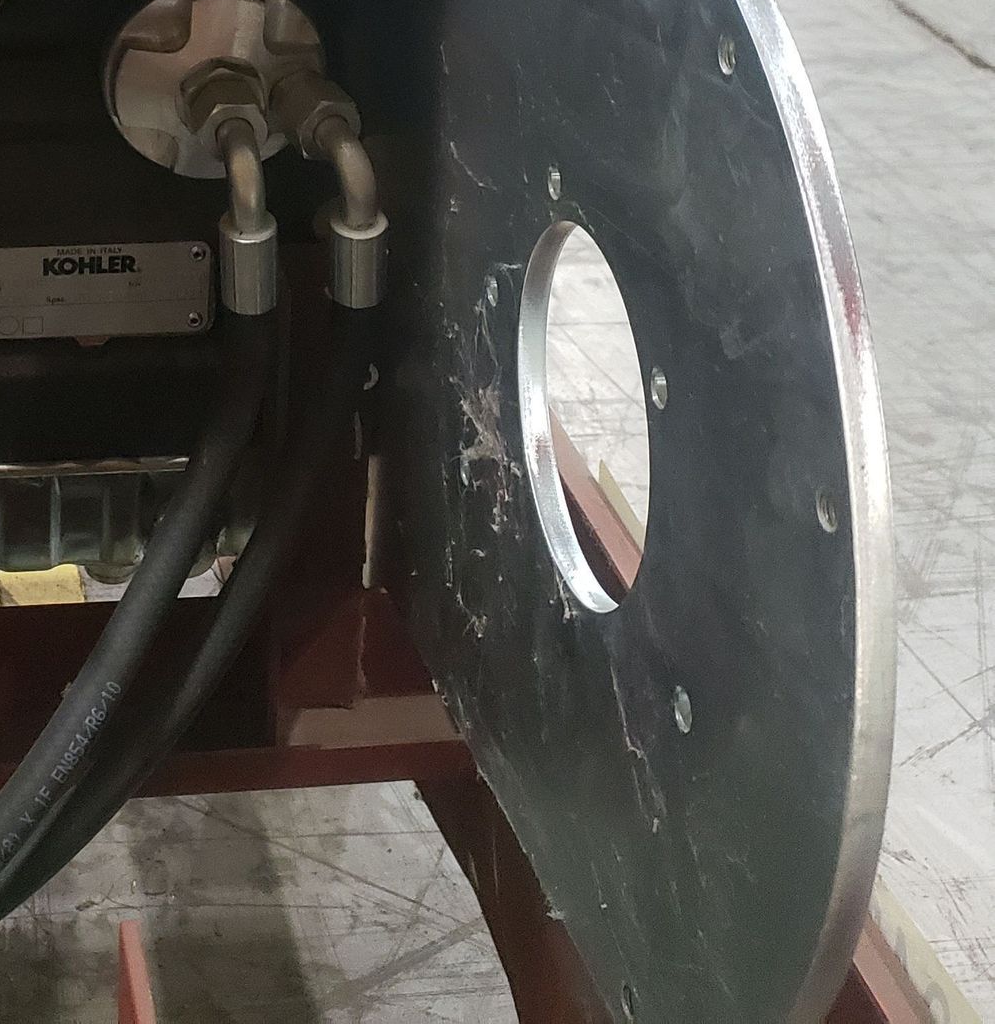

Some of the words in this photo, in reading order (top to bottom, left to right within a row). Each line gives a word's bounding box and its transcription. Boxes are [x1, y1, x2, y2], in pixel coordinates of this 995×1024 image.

[57, 247, 81, 256] MADE
[86, 246, 97, 255] IN
[100, 245, 123, 255] ITALY
[42, 255, 137, 276] KOHLER
[51, 680, 122, 783] EN854/R6/10
